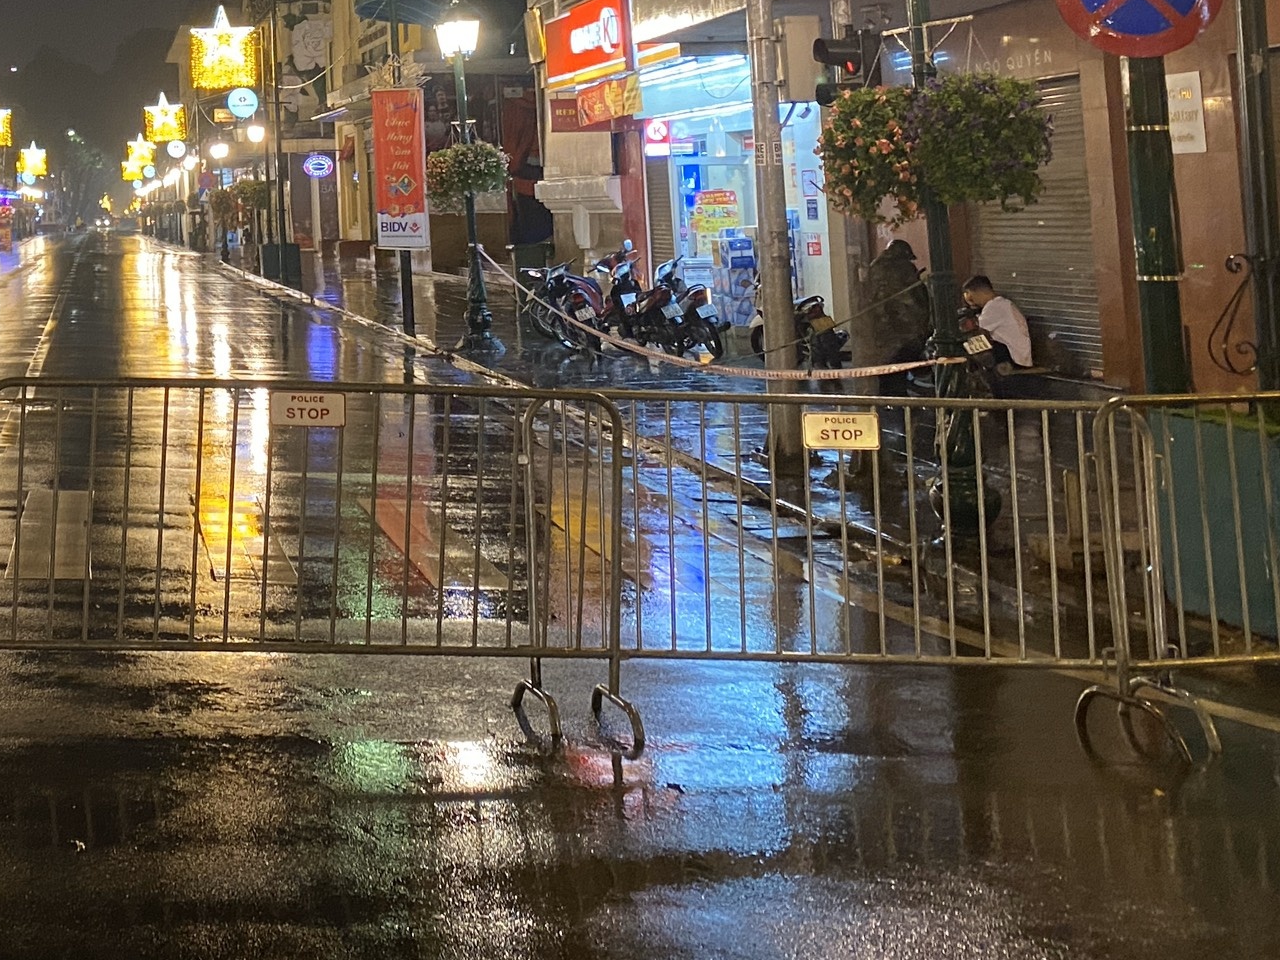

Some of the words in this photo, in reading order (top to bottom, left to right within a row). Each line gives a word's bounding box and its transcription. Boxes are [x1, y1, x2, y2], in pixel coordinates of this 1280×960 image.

[380, 221, 408, 233] BIDV
[291, 395, 324, 403] POLICE
[286, 407, 330, 419] STOP
[820, 429, 863, 441] STOP
